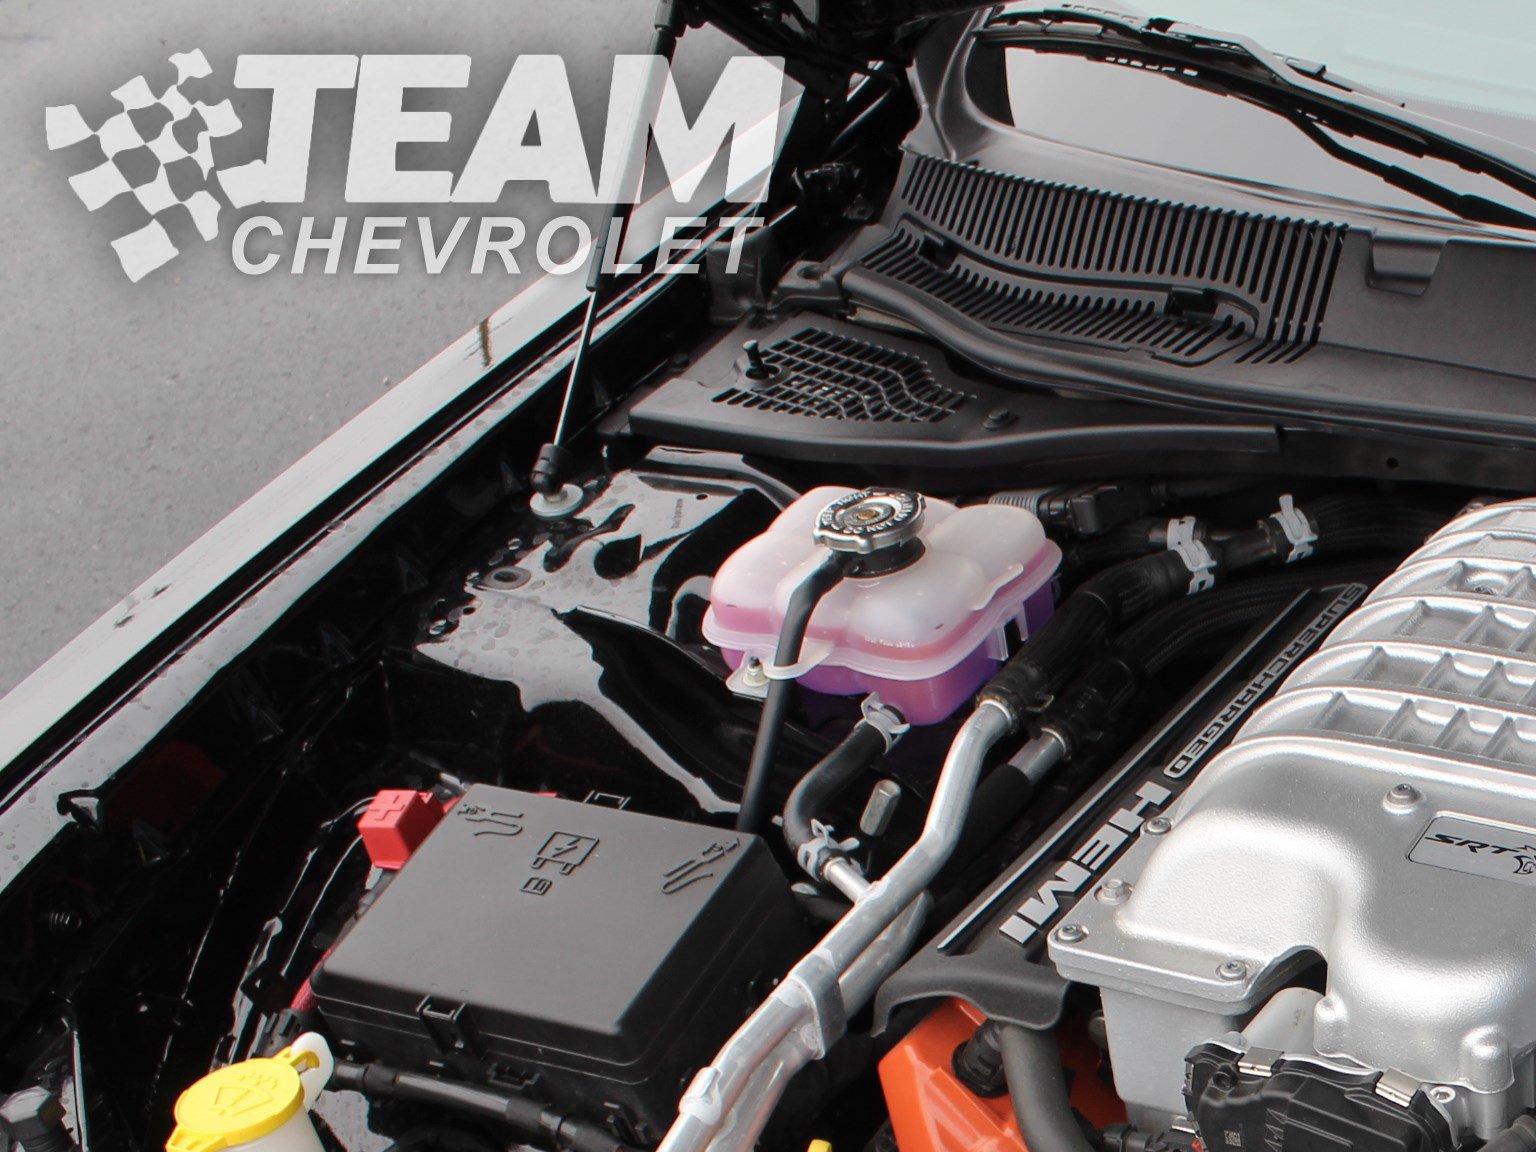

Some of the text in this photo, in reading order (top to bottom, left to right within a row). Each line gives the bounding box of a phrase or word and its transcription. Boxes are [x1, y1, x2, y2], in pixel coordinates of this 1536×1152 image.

[999, 583, 1367, 945] SUPERCHARGED HEMI
[1424, 833, 1521, 854] SRT
